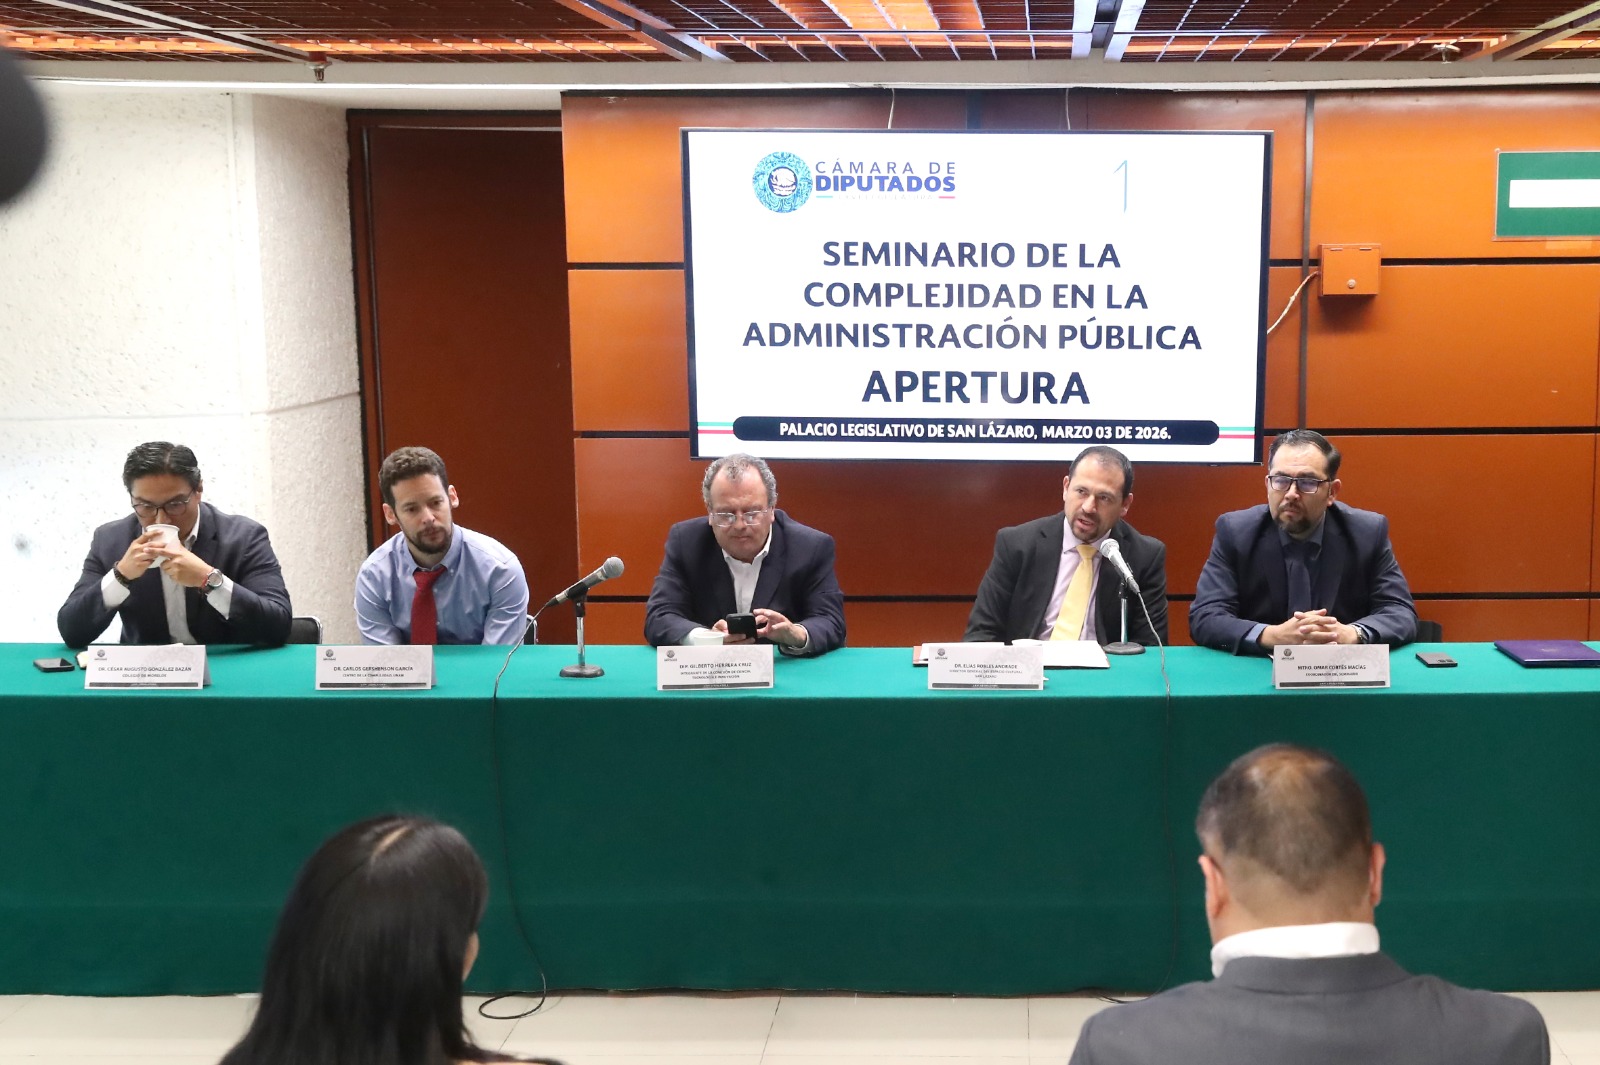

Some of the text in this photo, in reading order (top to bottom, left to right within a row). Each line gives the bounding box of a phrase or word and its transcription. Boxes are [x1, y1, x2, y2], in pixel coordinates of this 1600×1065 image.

[816, 159, 956, 174] CÁMARA DE
[815, 175, 956, 192] DIPUTADOS
[823, 241, 1121, 268] SEMINARIO DE LA
[804, 282, 1148, 310] COMPLEJIDAD EN LA
[742, 315, 1202, 350] ADMINISTRACIÓN PÚBLICA
[861, 370, 1091, 405] APERTURA
[779, 420, 1172, 440] PALACIO LEGISLATIVO DE SAN LÁZARO, MARZO 03 DE 2026.
